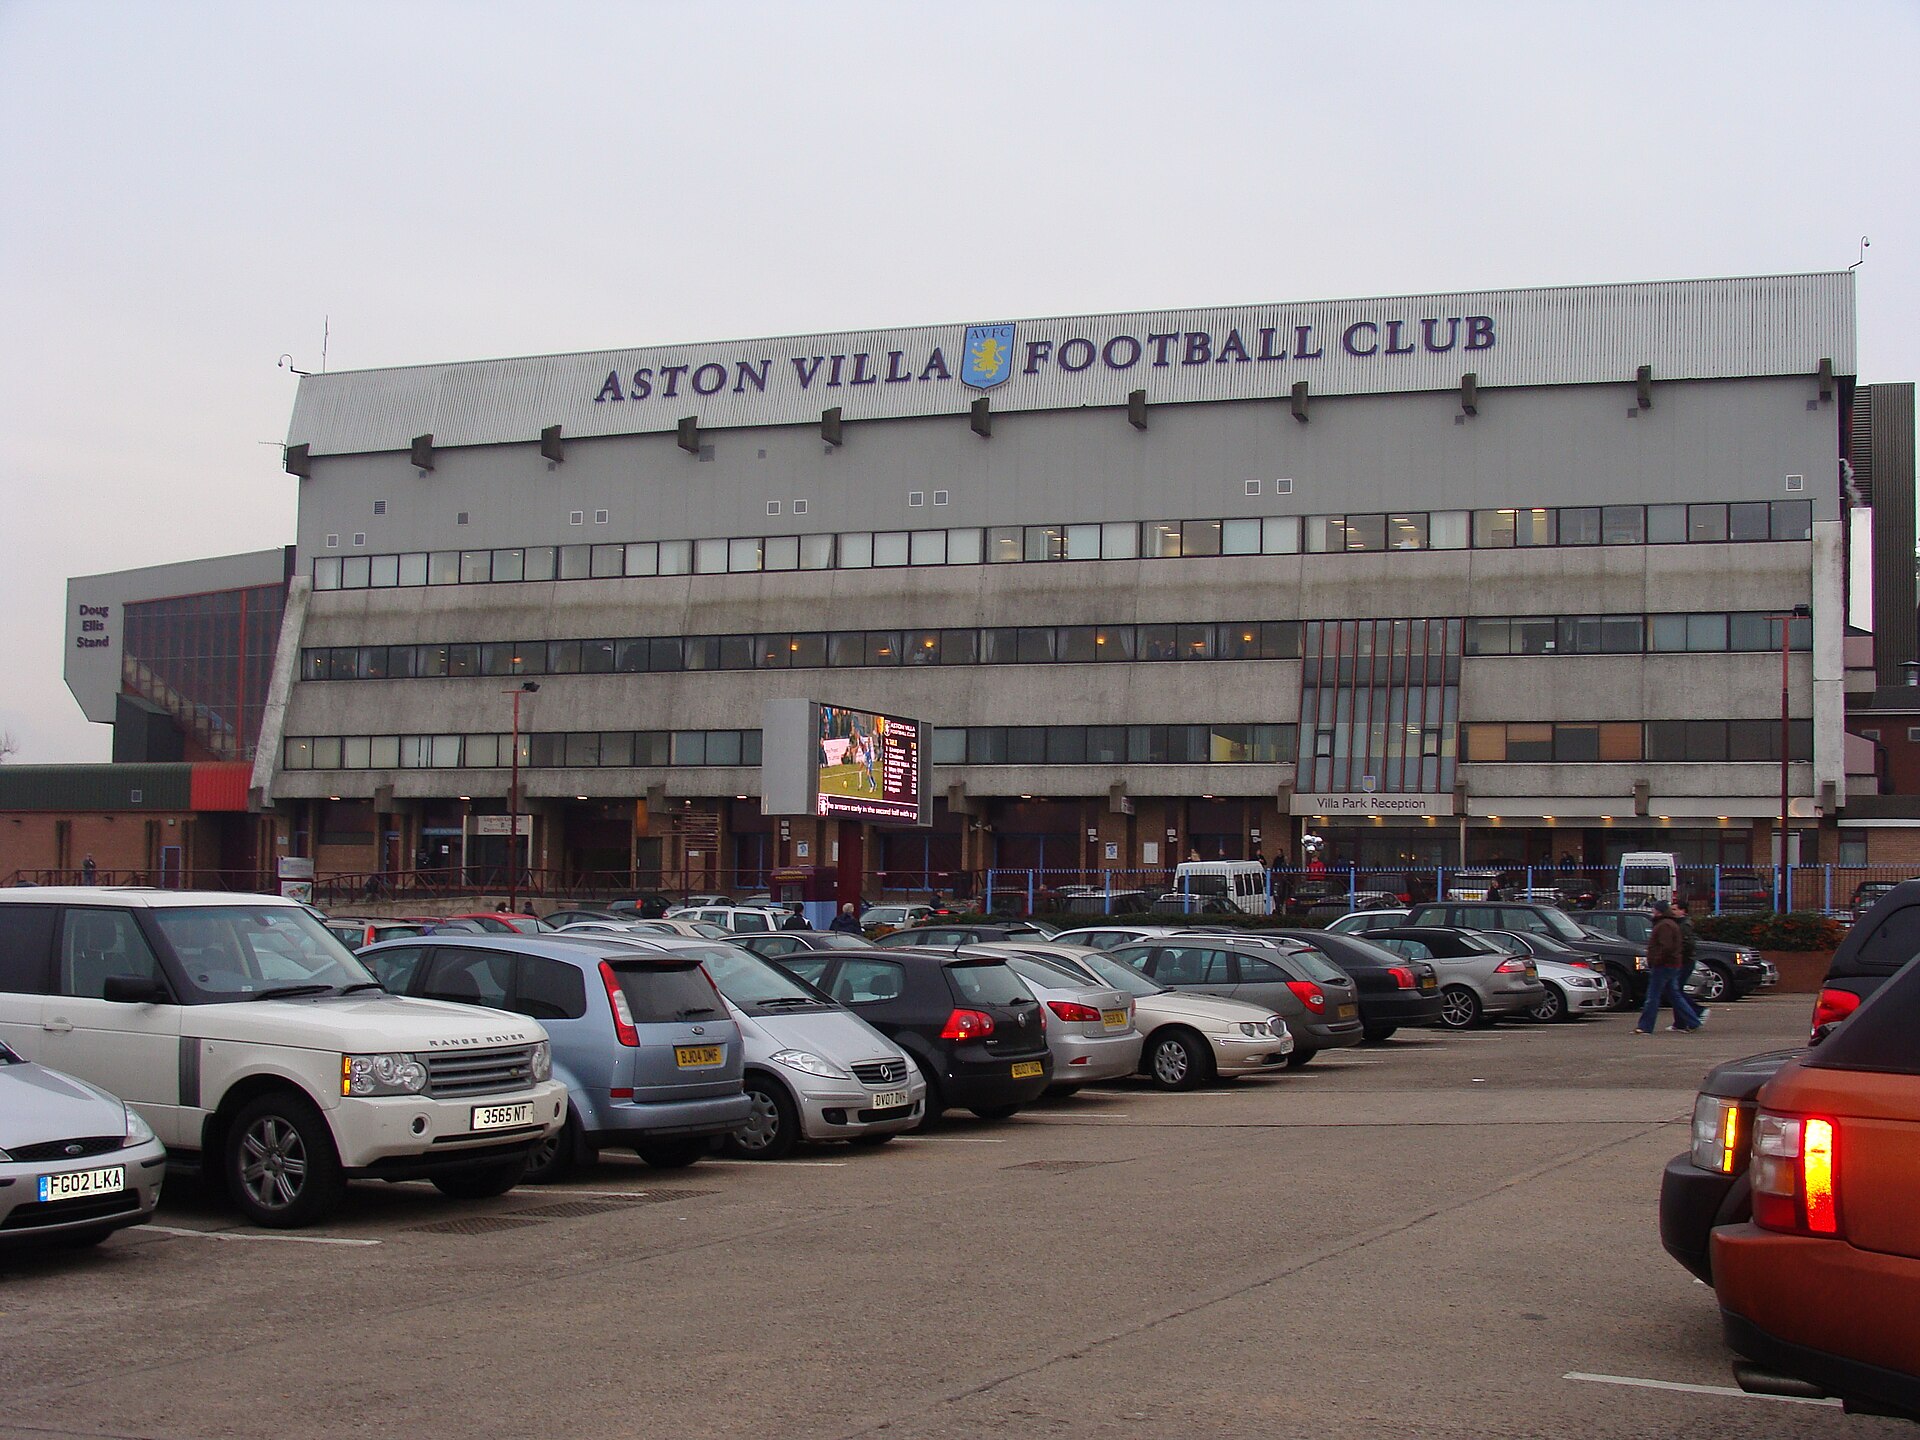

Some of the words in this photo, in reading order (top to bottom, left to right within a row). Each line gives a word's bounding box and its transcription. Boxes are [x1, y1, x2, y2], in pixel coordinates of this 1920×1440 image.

[971, 327, 1010, 339] AVFC
[1023, 326, 1323, 374] FOOTBALL
[1342, 314, 1497, 357] CLUB
[594, 359, 773, 402] ASTON
[791, 347, 952, 390] VILLA
[80, 604, 109, 618] Doug
[82, 620, 104, 631] Ellis
[76, 636, 109, 648] Stand
[851, 805, 862, 814] early
[867, 805, 876, 814] the
[1317, 798, 1339, 808] Villa
[1342, 798, 1367, 808] Park
[1371, 798, 1426, 811] Reception
[429, 1038, 479, 1047] RANGE
[486, 1033, 525, 1043] ROVER
[483, 1107, 512, 1123] 3565
[514, 1106, 526, 1121] NT
[51, 1173, 89, 1194] FG02
[94, 1170, 121, 1189] LKA
